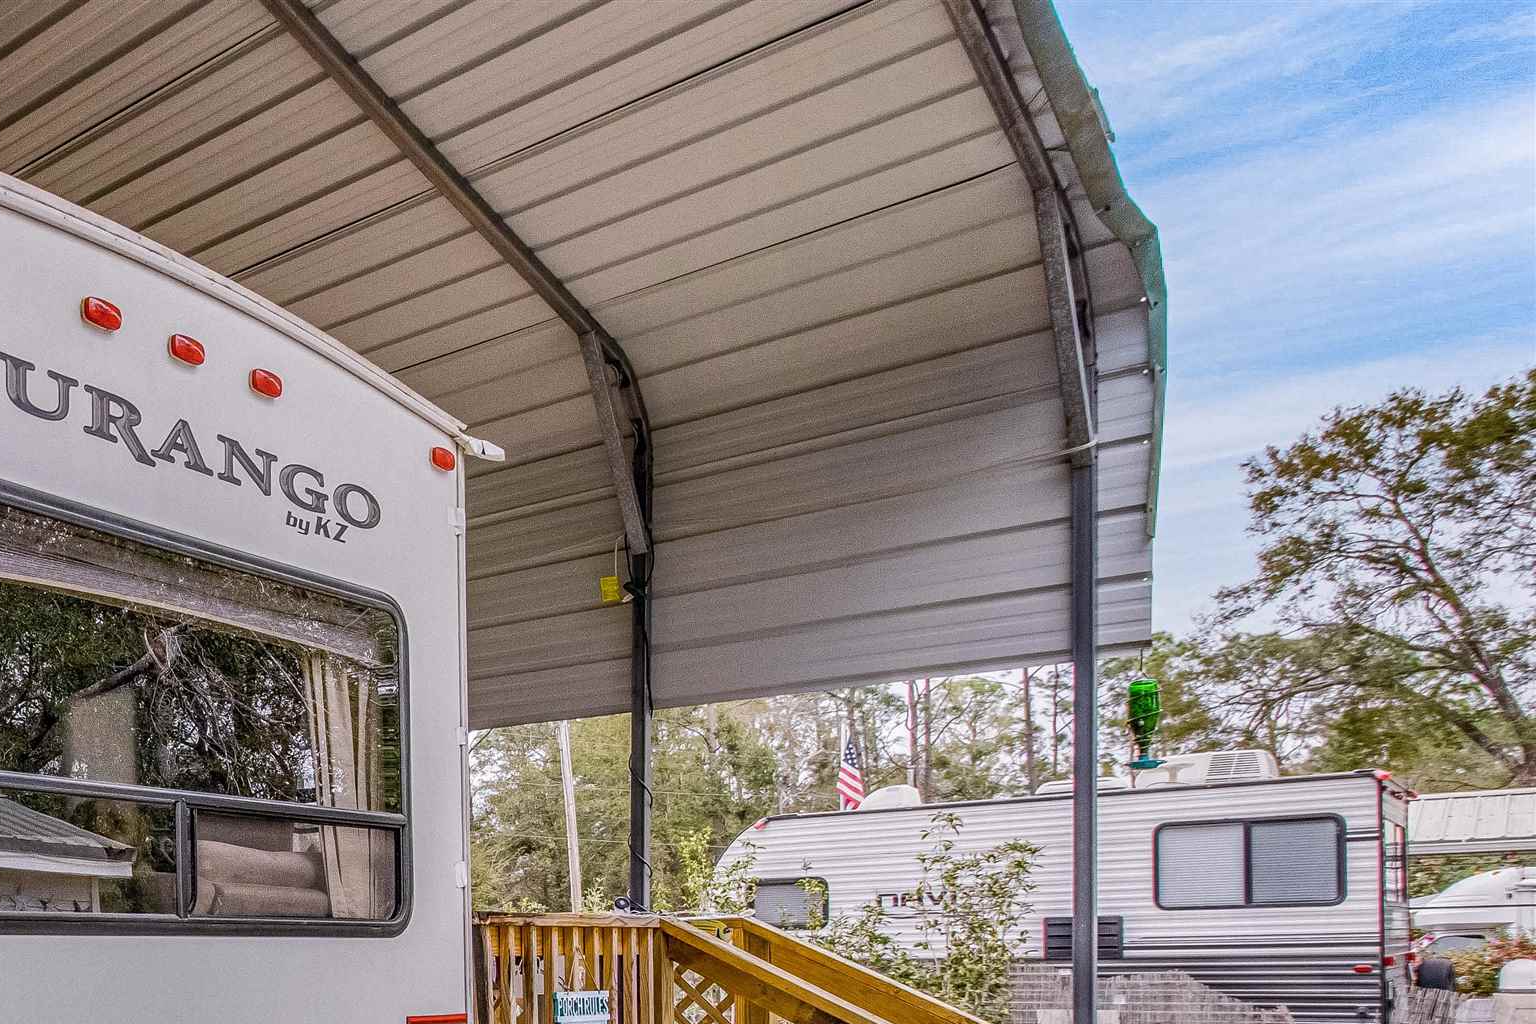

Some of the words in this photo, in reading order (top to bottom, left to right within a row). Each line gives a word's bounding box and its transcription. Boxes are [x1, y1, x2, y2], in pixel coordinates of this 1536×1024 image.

[285, 510, 310, 536] by
[314, 515, 349, 544] KZ
[559, 997, 584, 1016] PORCH
